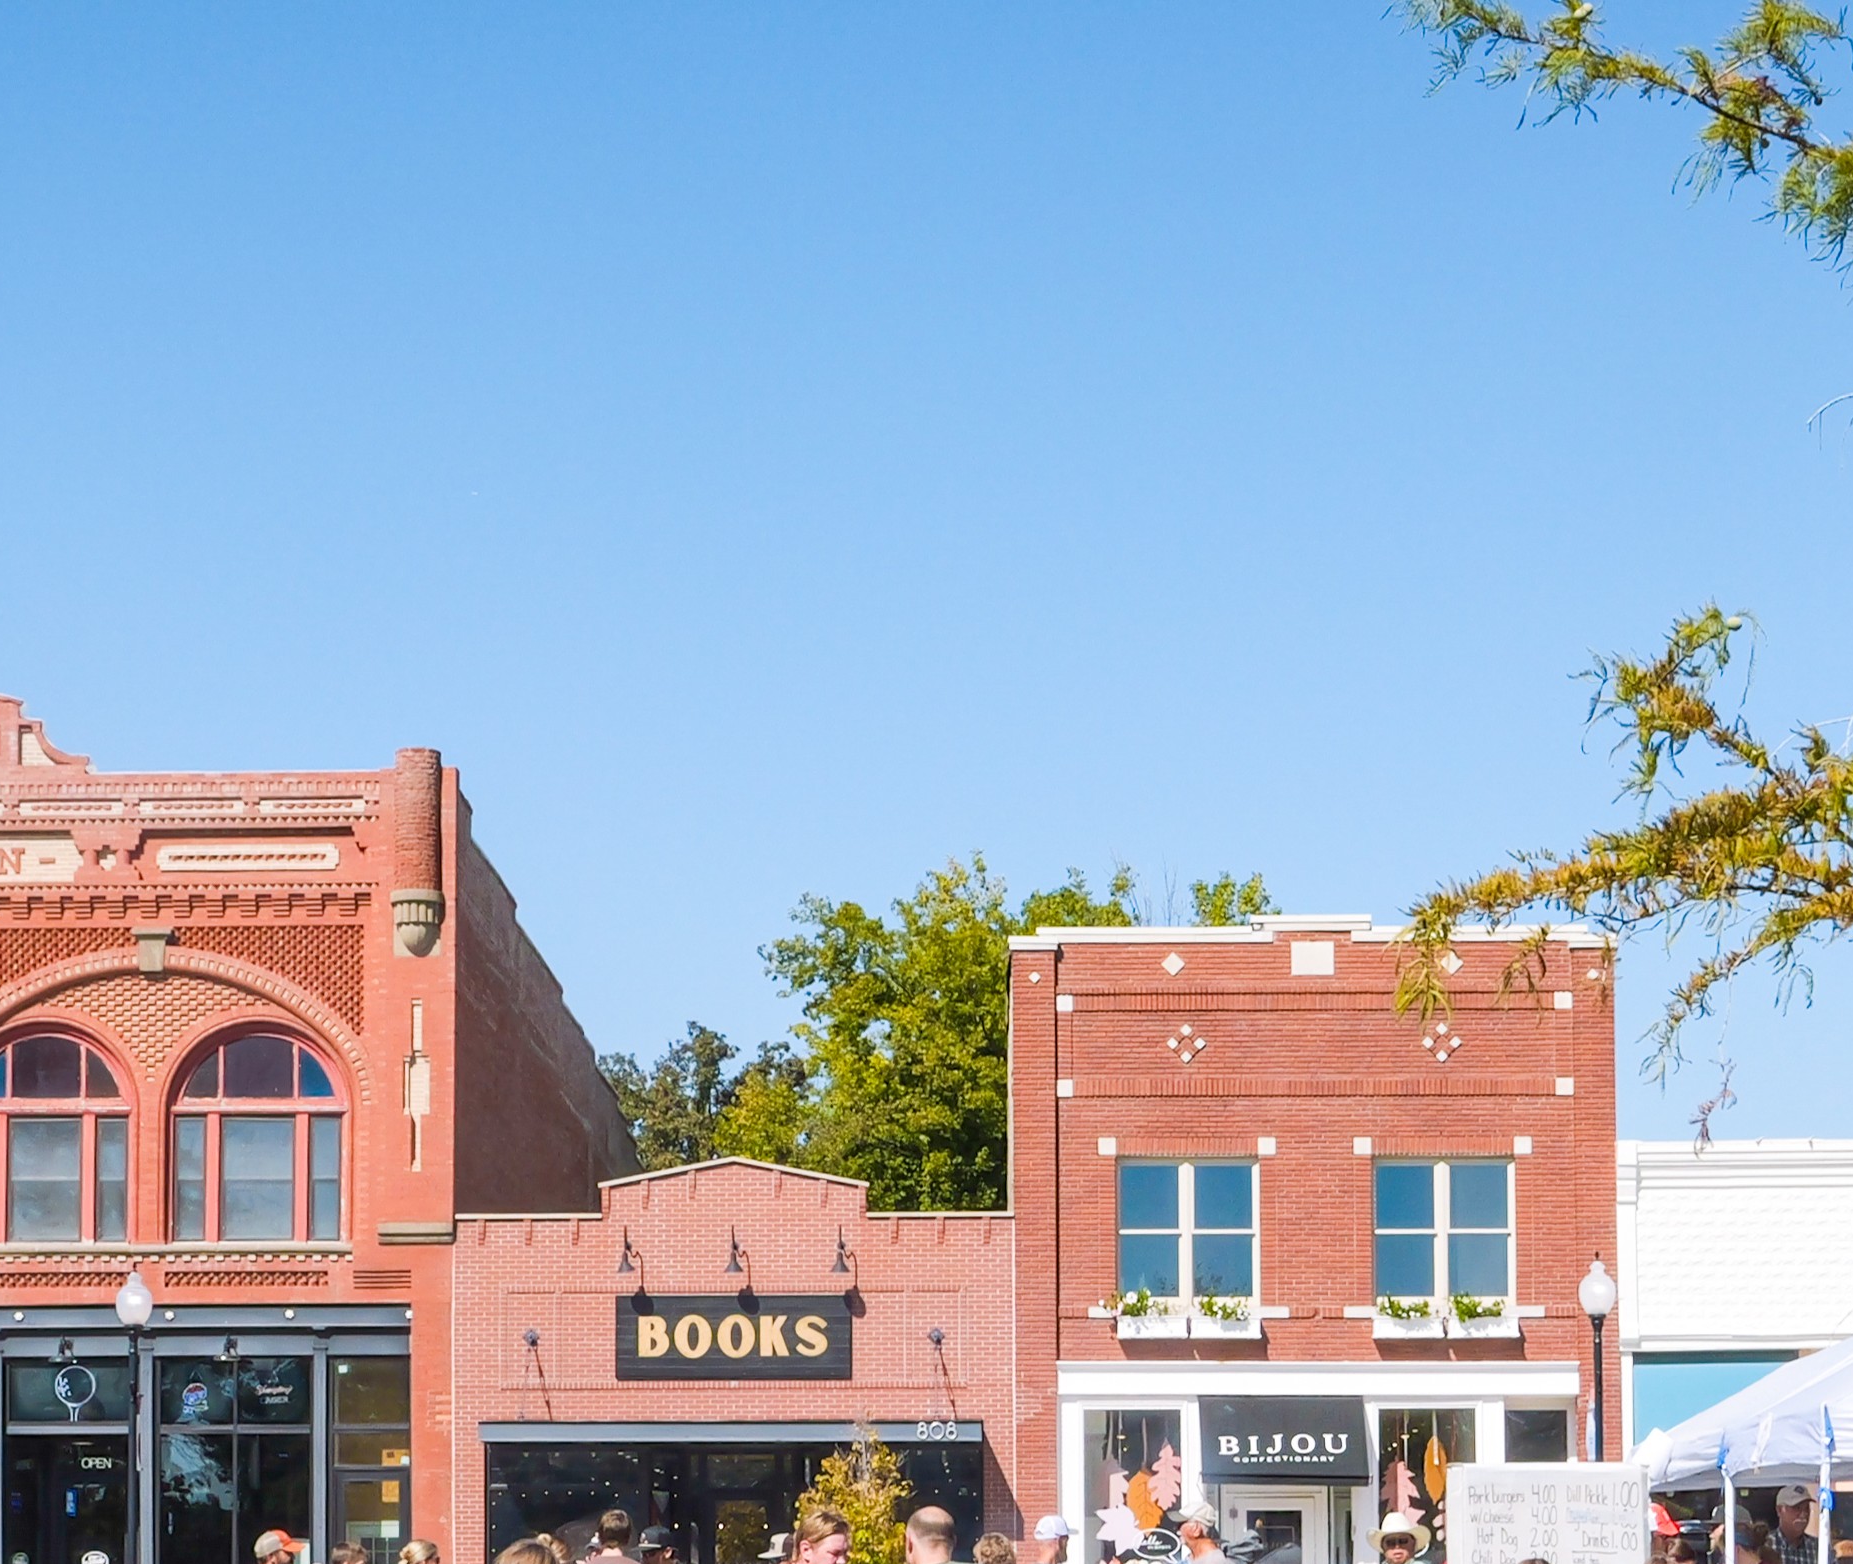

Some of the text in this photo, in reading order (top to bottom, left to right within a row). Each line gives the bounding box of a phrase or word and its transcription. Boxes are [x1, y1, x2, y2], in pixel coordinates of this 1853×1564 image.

[637, 1313, 829, 1359] BOOKS
[916, 1420, 958, 1440] 808
[1217, 1432, 1349, 1456] BIJOU
[80, 1456, 112, 1470] OPEN
[1476, 1526, 1494, 1545] Hot
[1500, 1527, 1518, 1554] Dog
[1471, 1549, 1493, 1564] Chili
